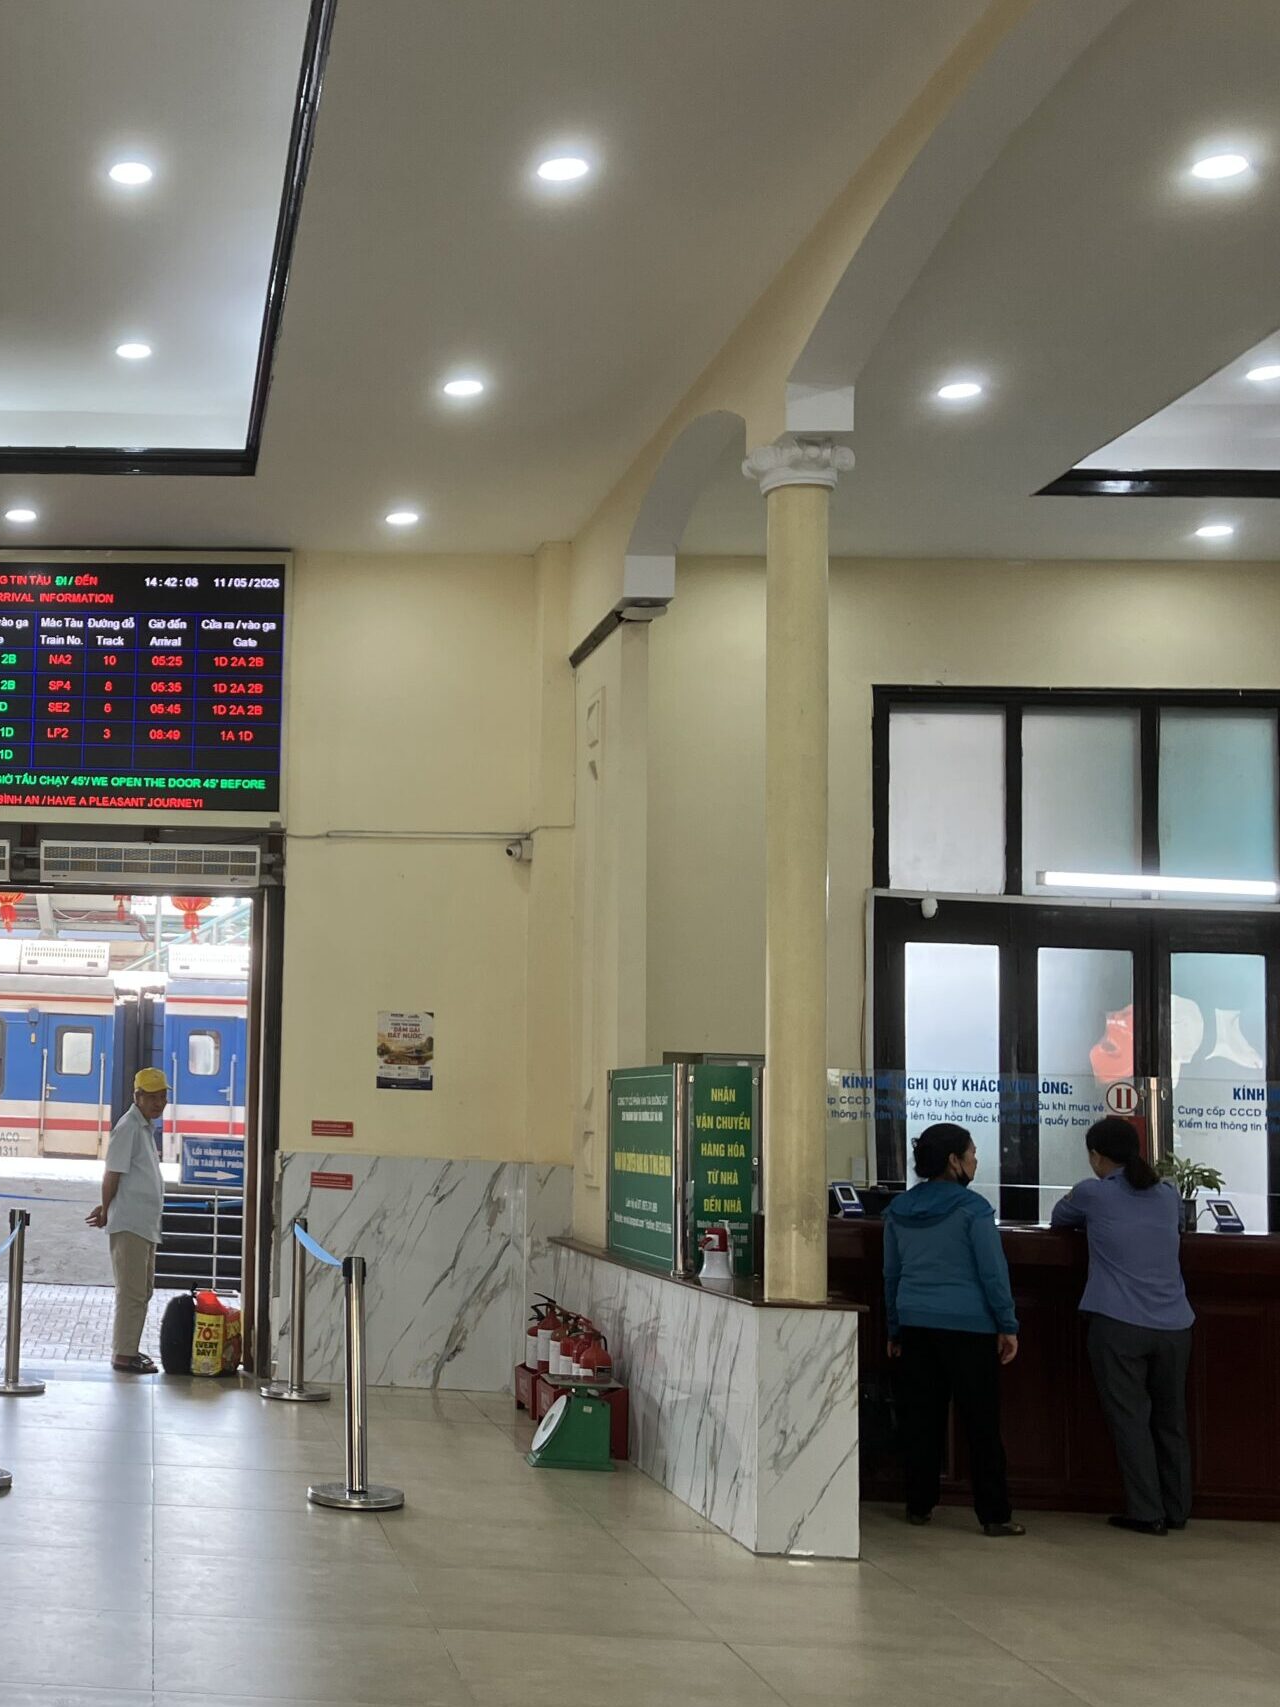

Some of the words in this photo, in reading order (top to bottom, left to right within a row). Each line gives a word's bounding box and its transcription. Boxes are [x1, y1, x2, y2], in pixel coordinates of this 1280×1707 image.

[10, 575, 27, 585] TIN
[30, 575, 51, 585] TÀU
[39, 593, 114, 603] INFORMATION
[16, 619, 28, 630] ga
[149, 636, 182, 646] Arrival
[49, 655, 72, 665] NA2
[103, 656, 116, 665] 10
[152, 656, 182, 666] 05:25
[39, 776, 69, 788] CHẠY
[92, 777, 108, 787] WE
[112, 777, 142, 787] OPEN
[143, 778, 166, 788] THE
[168, 778, 201, 788] DOOR
[220, 779, 266, 789] BEFORE
[24, 795, 40, 805] AN
[89, 797, 145, 807] PLEASANT
[842, 1073, 873, 1088] KÍNH
[933, 1075, 957, 1091] QUÝ
[711, 1086, 736, 1105] NHẬN
[1233, 1085, 1264, 1100] KÍNH
[839, 1096, 870, 1104] CCCD
[951, 1098, 971, 1108] thân
[1052, 1102, 1066, 1111] khi
[1069, 1104, 1090, 1112] mua
[832, 1110, 857, 1119] thông
[1178, 1105, 1203, 1117] Cung
[1206, 1106, 1225, 1116] cấp
[1230, 1108, 1261, 1116] CCCD
[696, 1113, 714, 1131] VẬN
[716, 1112, 750, 1130] CHUYỂN
[1205, 1120, 1217, 1129] tra
[1220, 1121, 1247, 1132] thông
[1251, 1122, 1261, 1130] tin
[701, 1141, 725, 1157] HÀNG
[727, 1142, 745, 1158] HÓA
[720, 1171, 738, 1185] NHÀ
[724, 1197, 742, 1213] NHÀ
